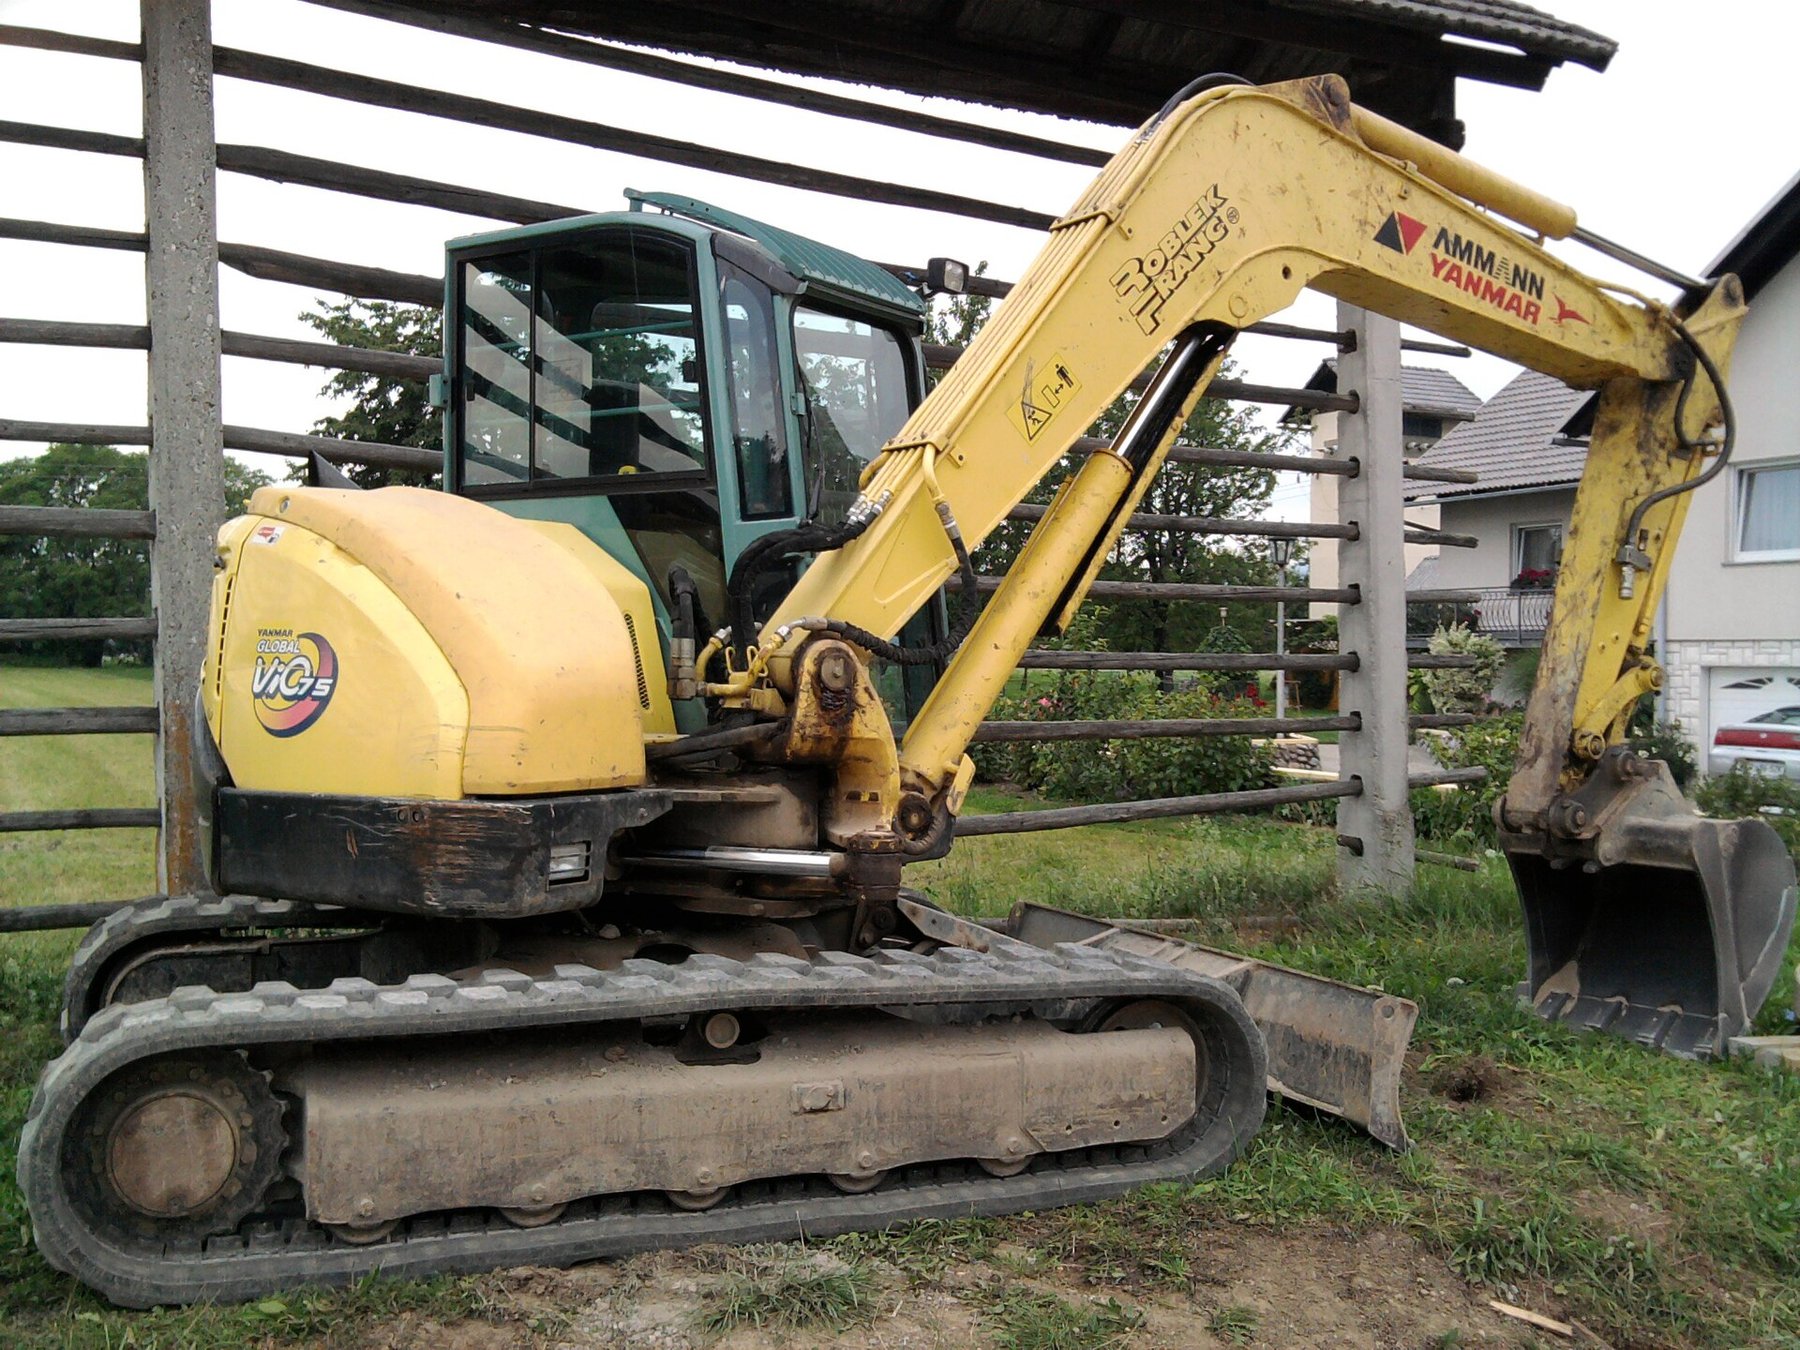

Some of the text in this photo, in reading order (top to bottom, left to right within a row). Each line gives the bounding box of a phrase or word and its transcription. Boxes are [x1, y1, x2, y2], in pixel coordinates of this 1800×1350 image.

[1109, 183, 1228, 297] ROBLEK
[1433, 227, 1545, 299] AMMANN
[1430, 253, 1542, 325] YANMAR
[257, 629, 293, 637] YANMAR
[257, 640, 300, 653] GLOBAL
